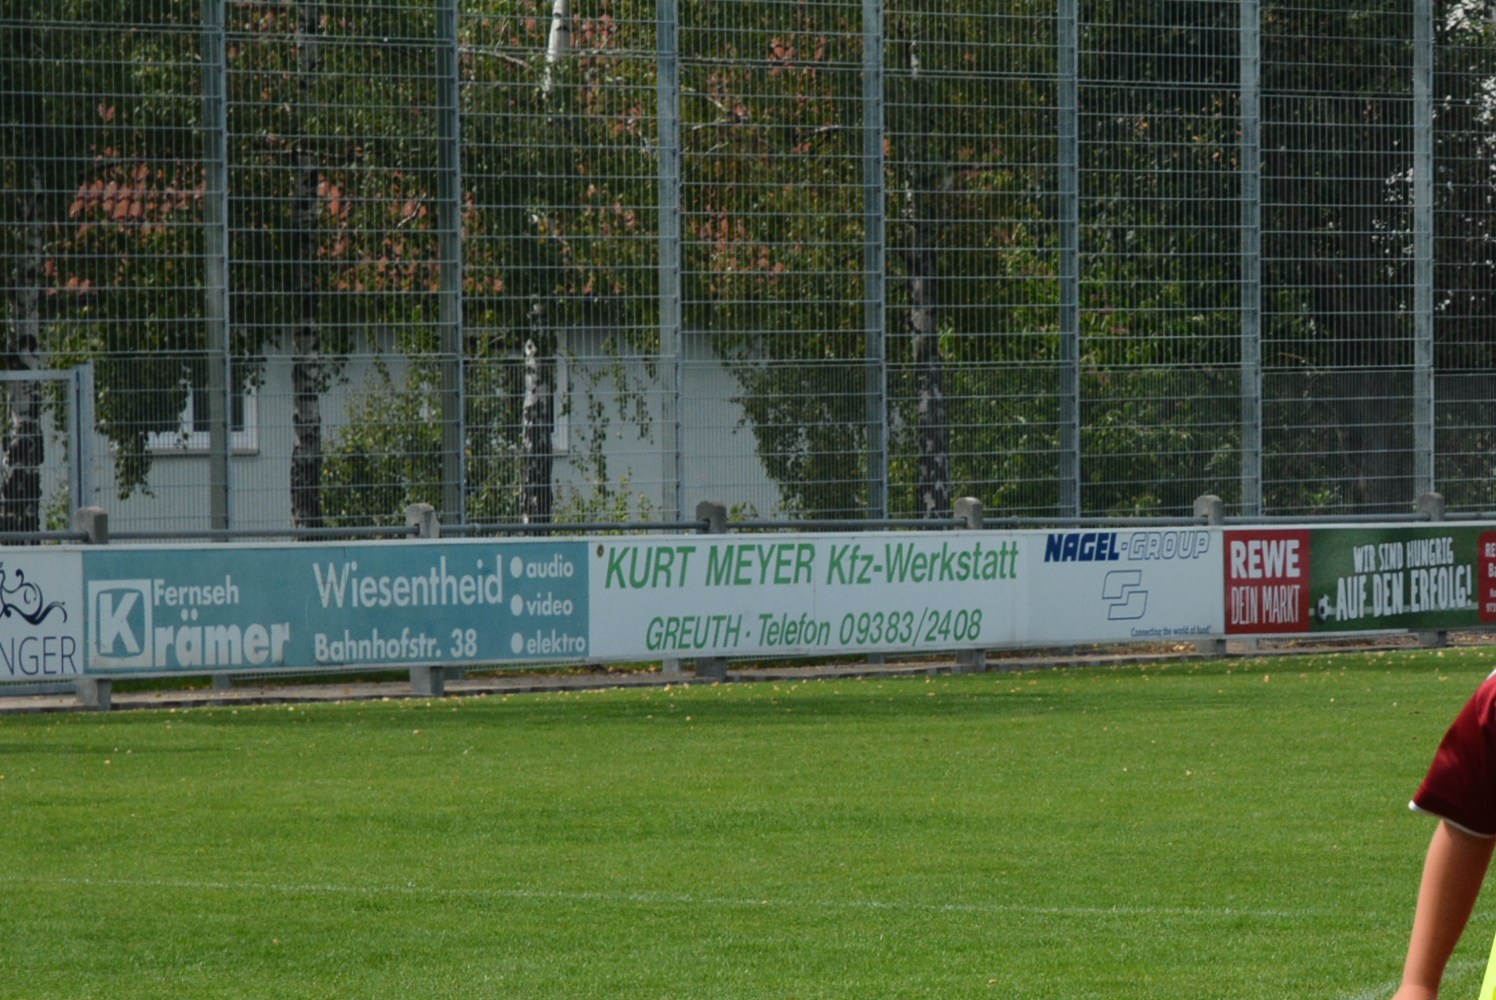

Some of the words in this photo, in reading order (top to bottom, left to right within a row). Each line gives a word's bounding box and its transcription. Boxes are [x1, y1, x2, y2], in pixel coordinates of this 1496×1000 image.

[526, 553, 574, 578] audio
[605, 546, 697, 589] KURT
[705, 543, 816, 587] MEYER
[826, 541, 1019, 585] Kfz-Werkstatt
[1230, 539, 1301, 579] REWE
[1353, 545, 1376, 573] WIR
[1378, 541, 1404, 571] SIND
[1406, 537, 1454, 568] HUNGRIG
[154, 575, 239, 606] Fernseh
[313, 555, 503, 608] Wiesentheid
[1336, 575, 1367, 621] AUF
[1373, 572, 1404, 617] DEN
[1410, 564, 1472, 612] ERFOLG!
[526, 592, 574, 616] video
[1231, 586, 1259, 625] DEIN
[1262, 584, 1301, 624] MARKT
[315, 627, 442, 662] Bahnhofstr.
[451, 628, 478, 658] 38
[526, 629, 586, 654] elektro
[646, 614, 742, 650] GREUTH
[759, 612, 830, 646] Telefon
[839, 607, 983, 647] 09383/2408
